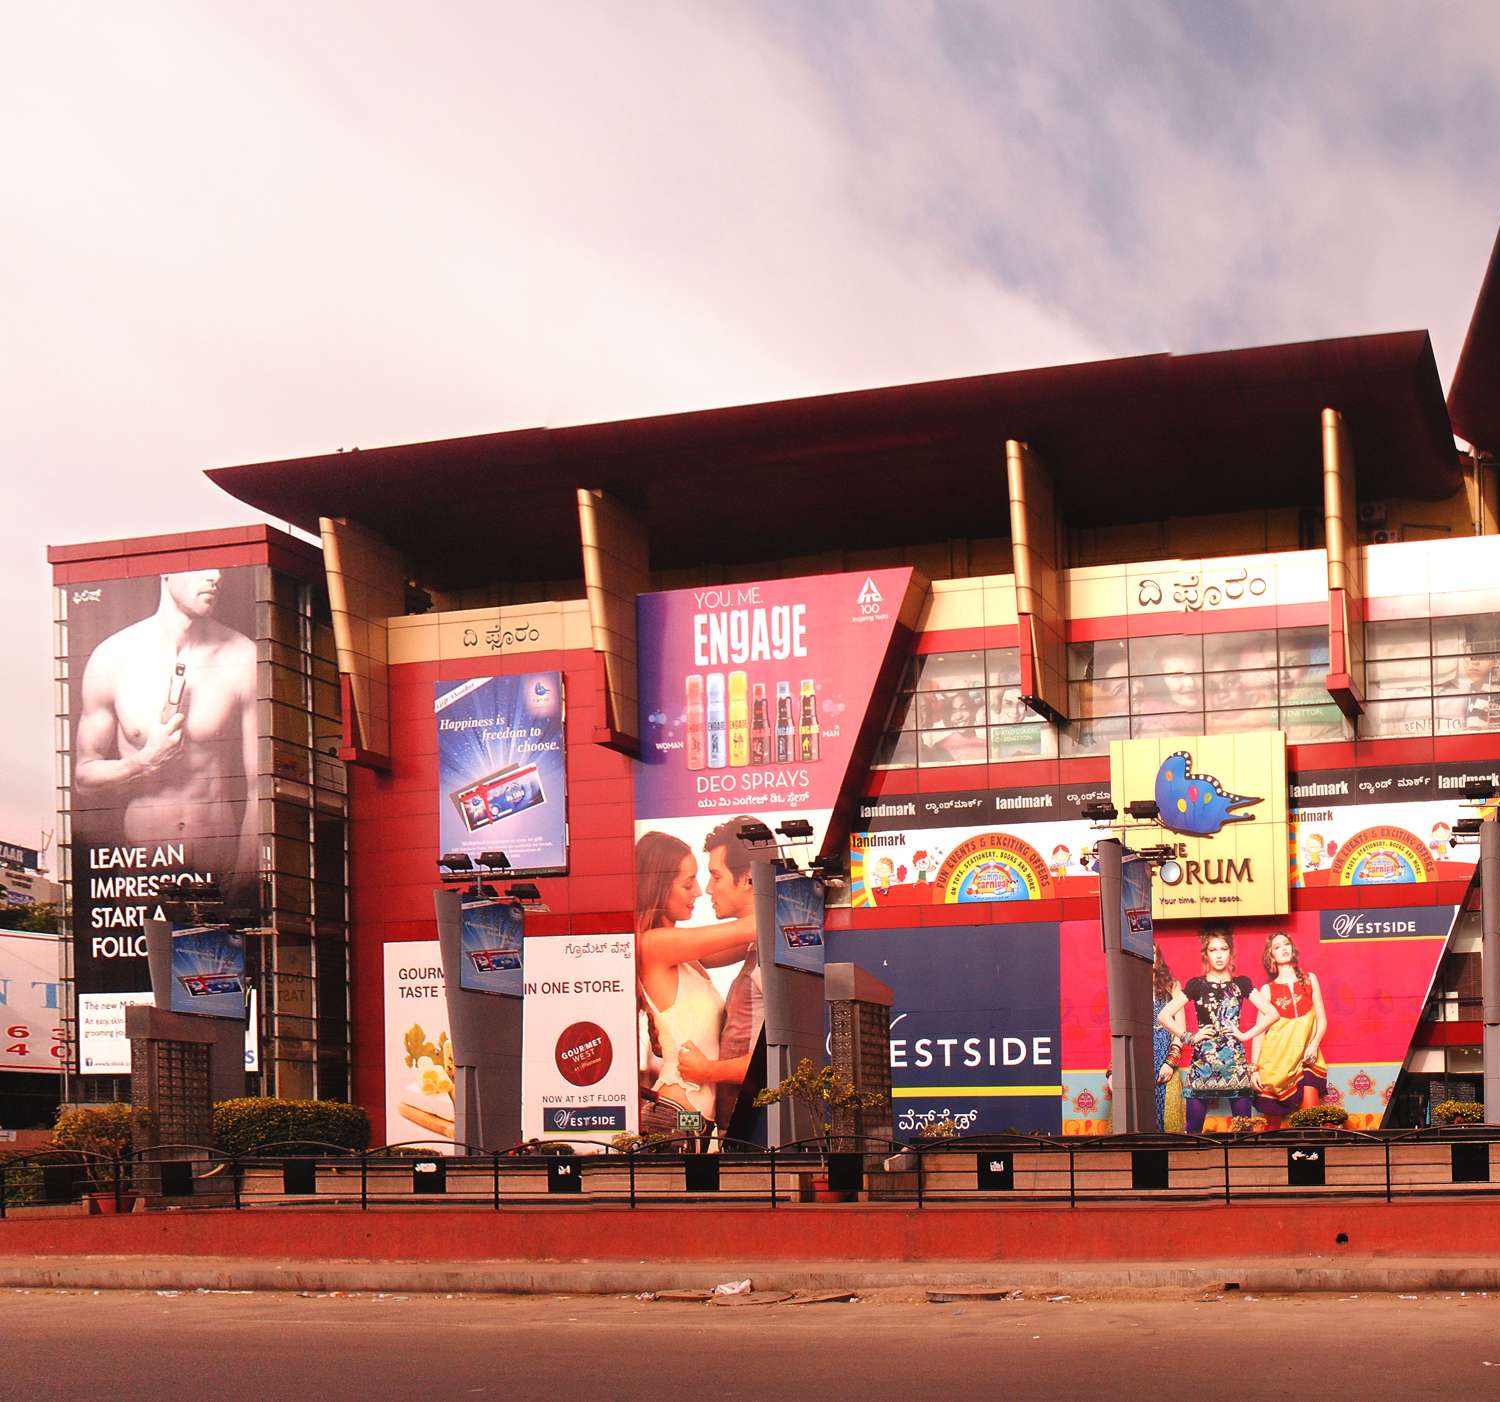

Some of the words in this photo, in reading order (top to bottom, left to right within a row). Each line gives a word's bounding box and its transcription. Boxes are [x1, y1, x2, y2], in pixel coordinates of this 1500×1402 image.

[440, 716, 494, 731] Happiness
[495, 714, 505, 725] is
[482, 727, 527, 741] freedom
[530, 727, 541, 737] to
[697, 774, 737, 793] DEO
[740, 769, 810, 791] SPRAYS
[860, 801, 916, 818] landmark
[995, 794, 1053, 810] landmark
[853, 834, 906, 848] landmark
[90, 847, 147, 869] LEAVE
[151, 843, 184, 867] AN
[91, 906, 147, 929] START
[398, 986, 438, 998] TASTE
[541, 982, 570, 994] ONE
[573, 980, 624, 993] STORE.
[561, 1037, 602, 1060] GOURMET
